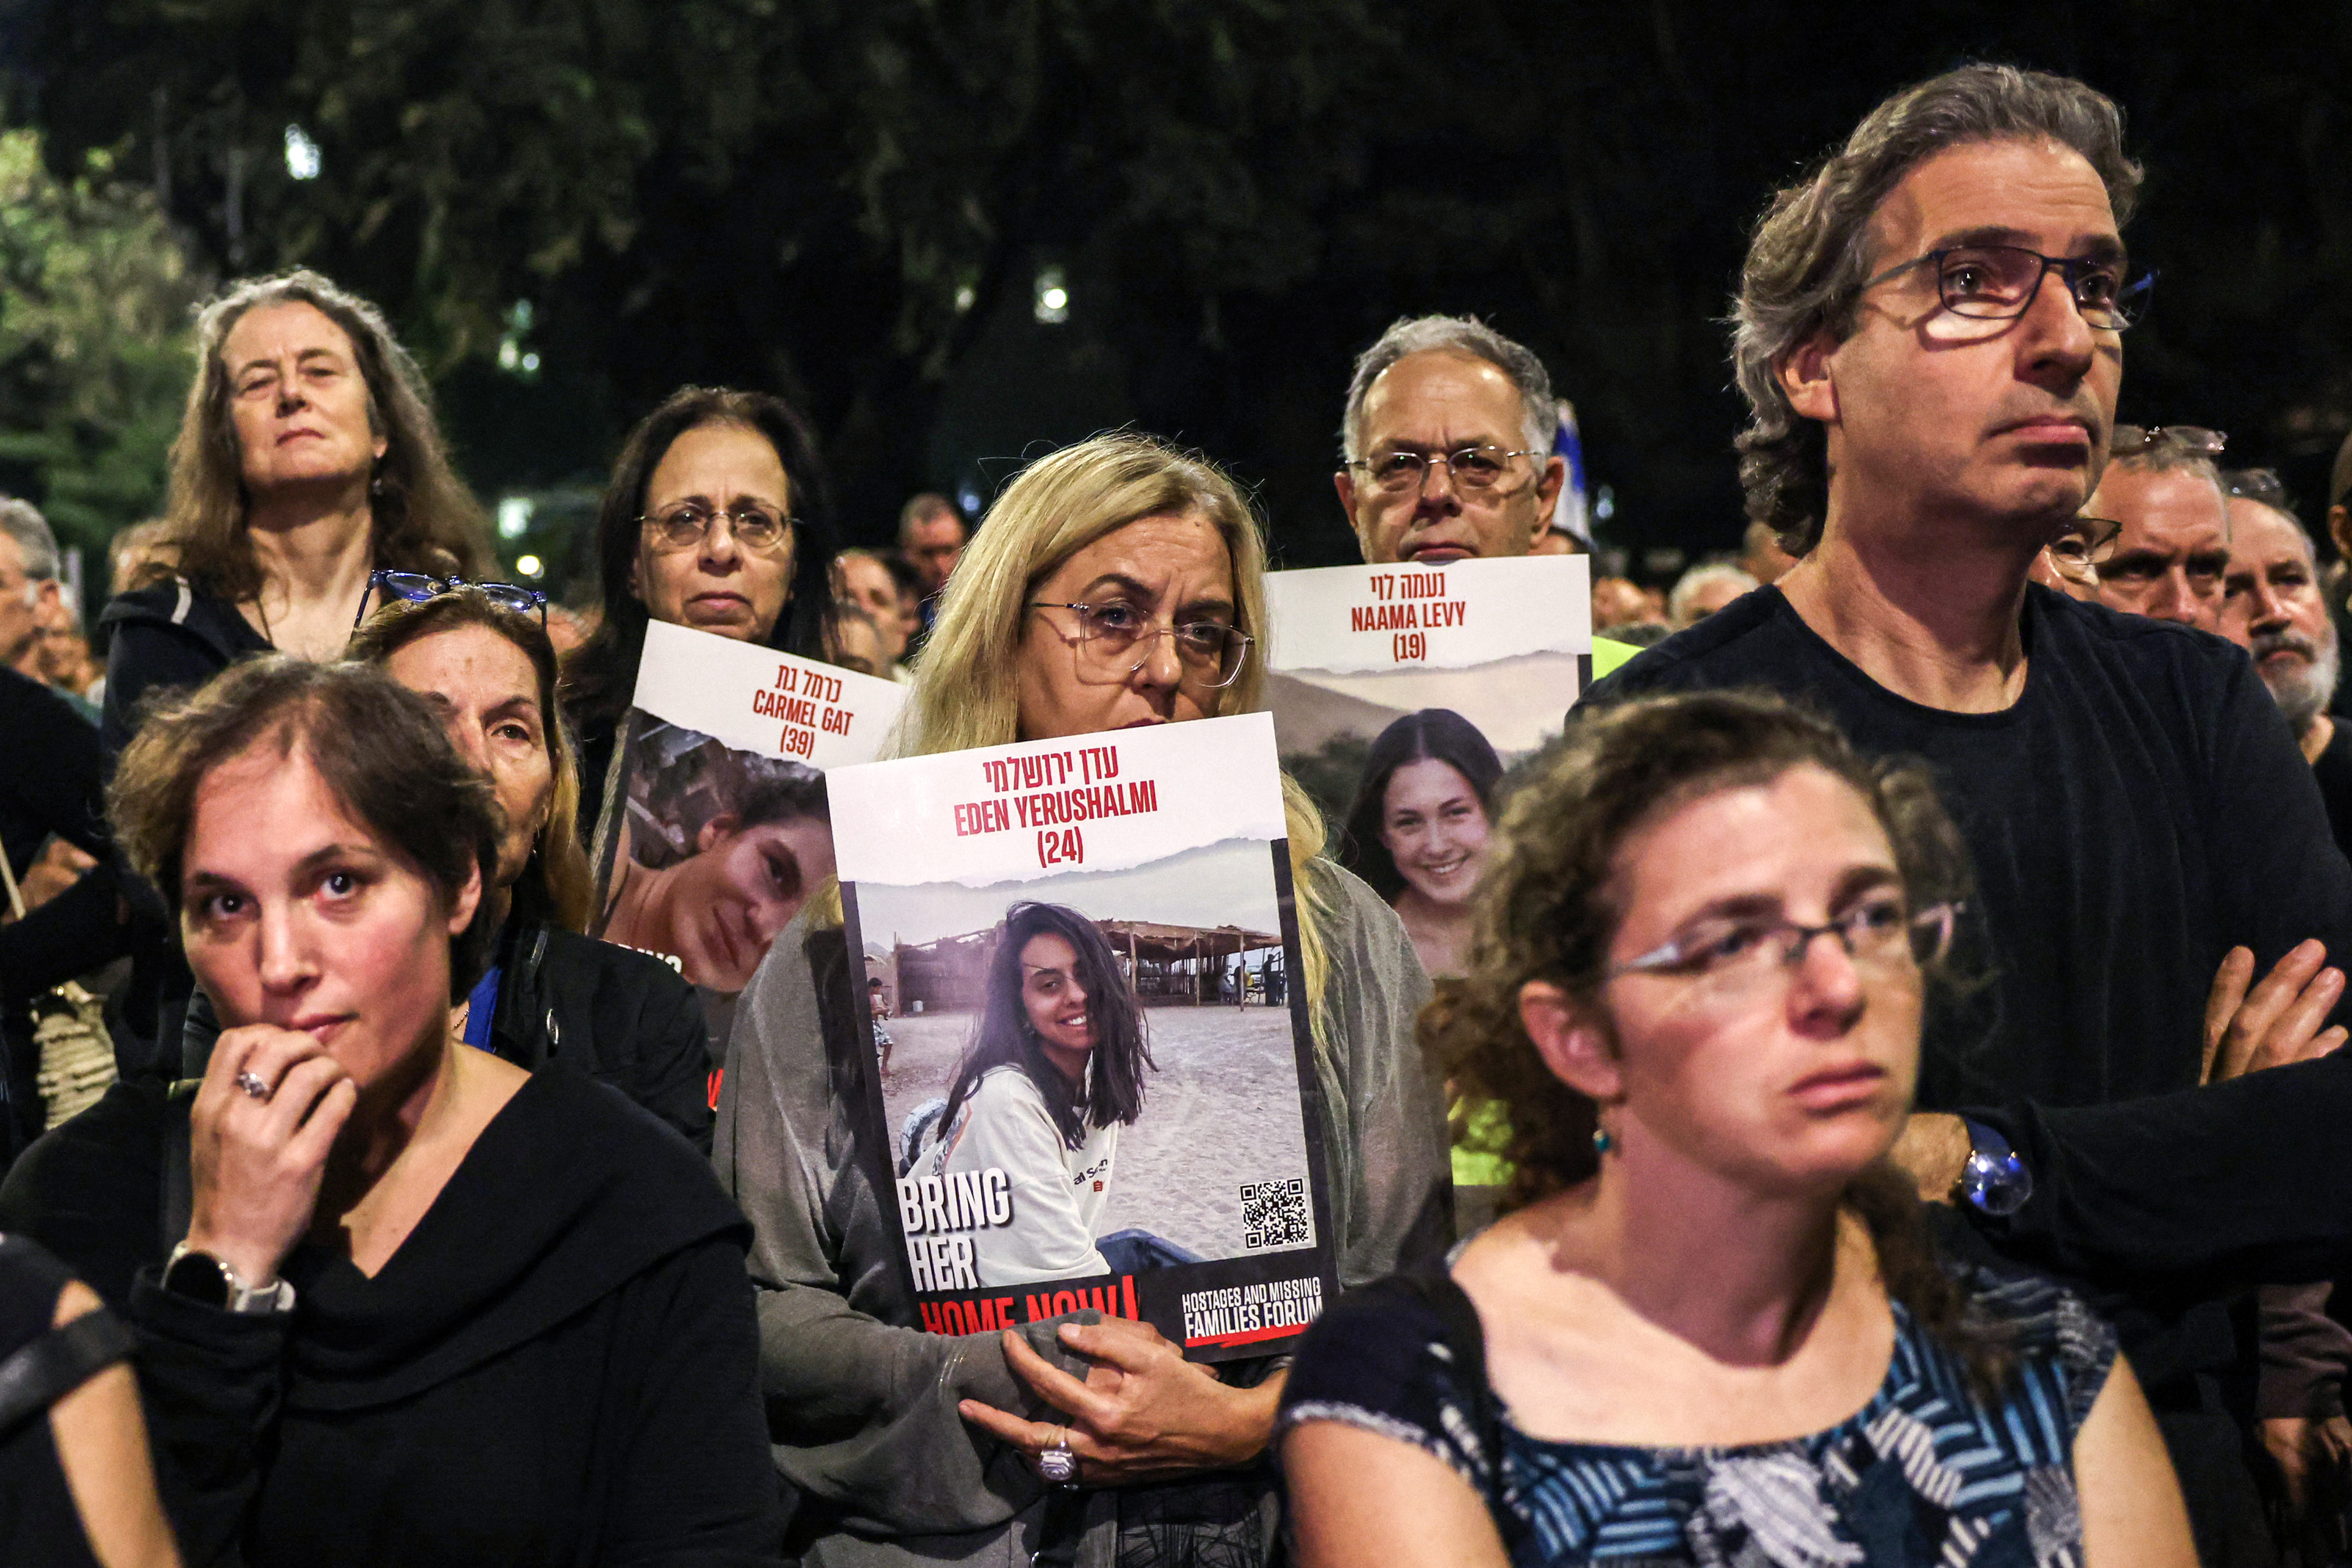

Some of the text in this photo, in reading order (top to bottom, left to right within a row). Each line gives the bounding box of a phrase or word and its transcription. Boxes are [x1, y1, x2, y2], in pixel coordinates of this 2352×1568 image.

[1370, 572, 1445, 600] נעמה לוי
[1352, 601, 1466, 632] NAAMA LEVY
[1394, 632, 1426, 662] (19)
[775, 665, 842, 703] כרמל גת
[753, 689, 854, 736] CARMEL GAT
[780, 725, 815, 759] (39)
[983, 746, 1119, 793] עדן ירושלמי
[954, 780, 1158, 836] EDEN YERUSHALMI
[1038, 826, 1083, 868] (24)
[896, 1167, 1010, 1232] BRING
[906, 1235, 979, 1292] HER
[1182, 1276, 1321, 1313] HOSTAGES AND MISSING
[1184, 1296, 1323, 1339] FAMILIES FORUM
